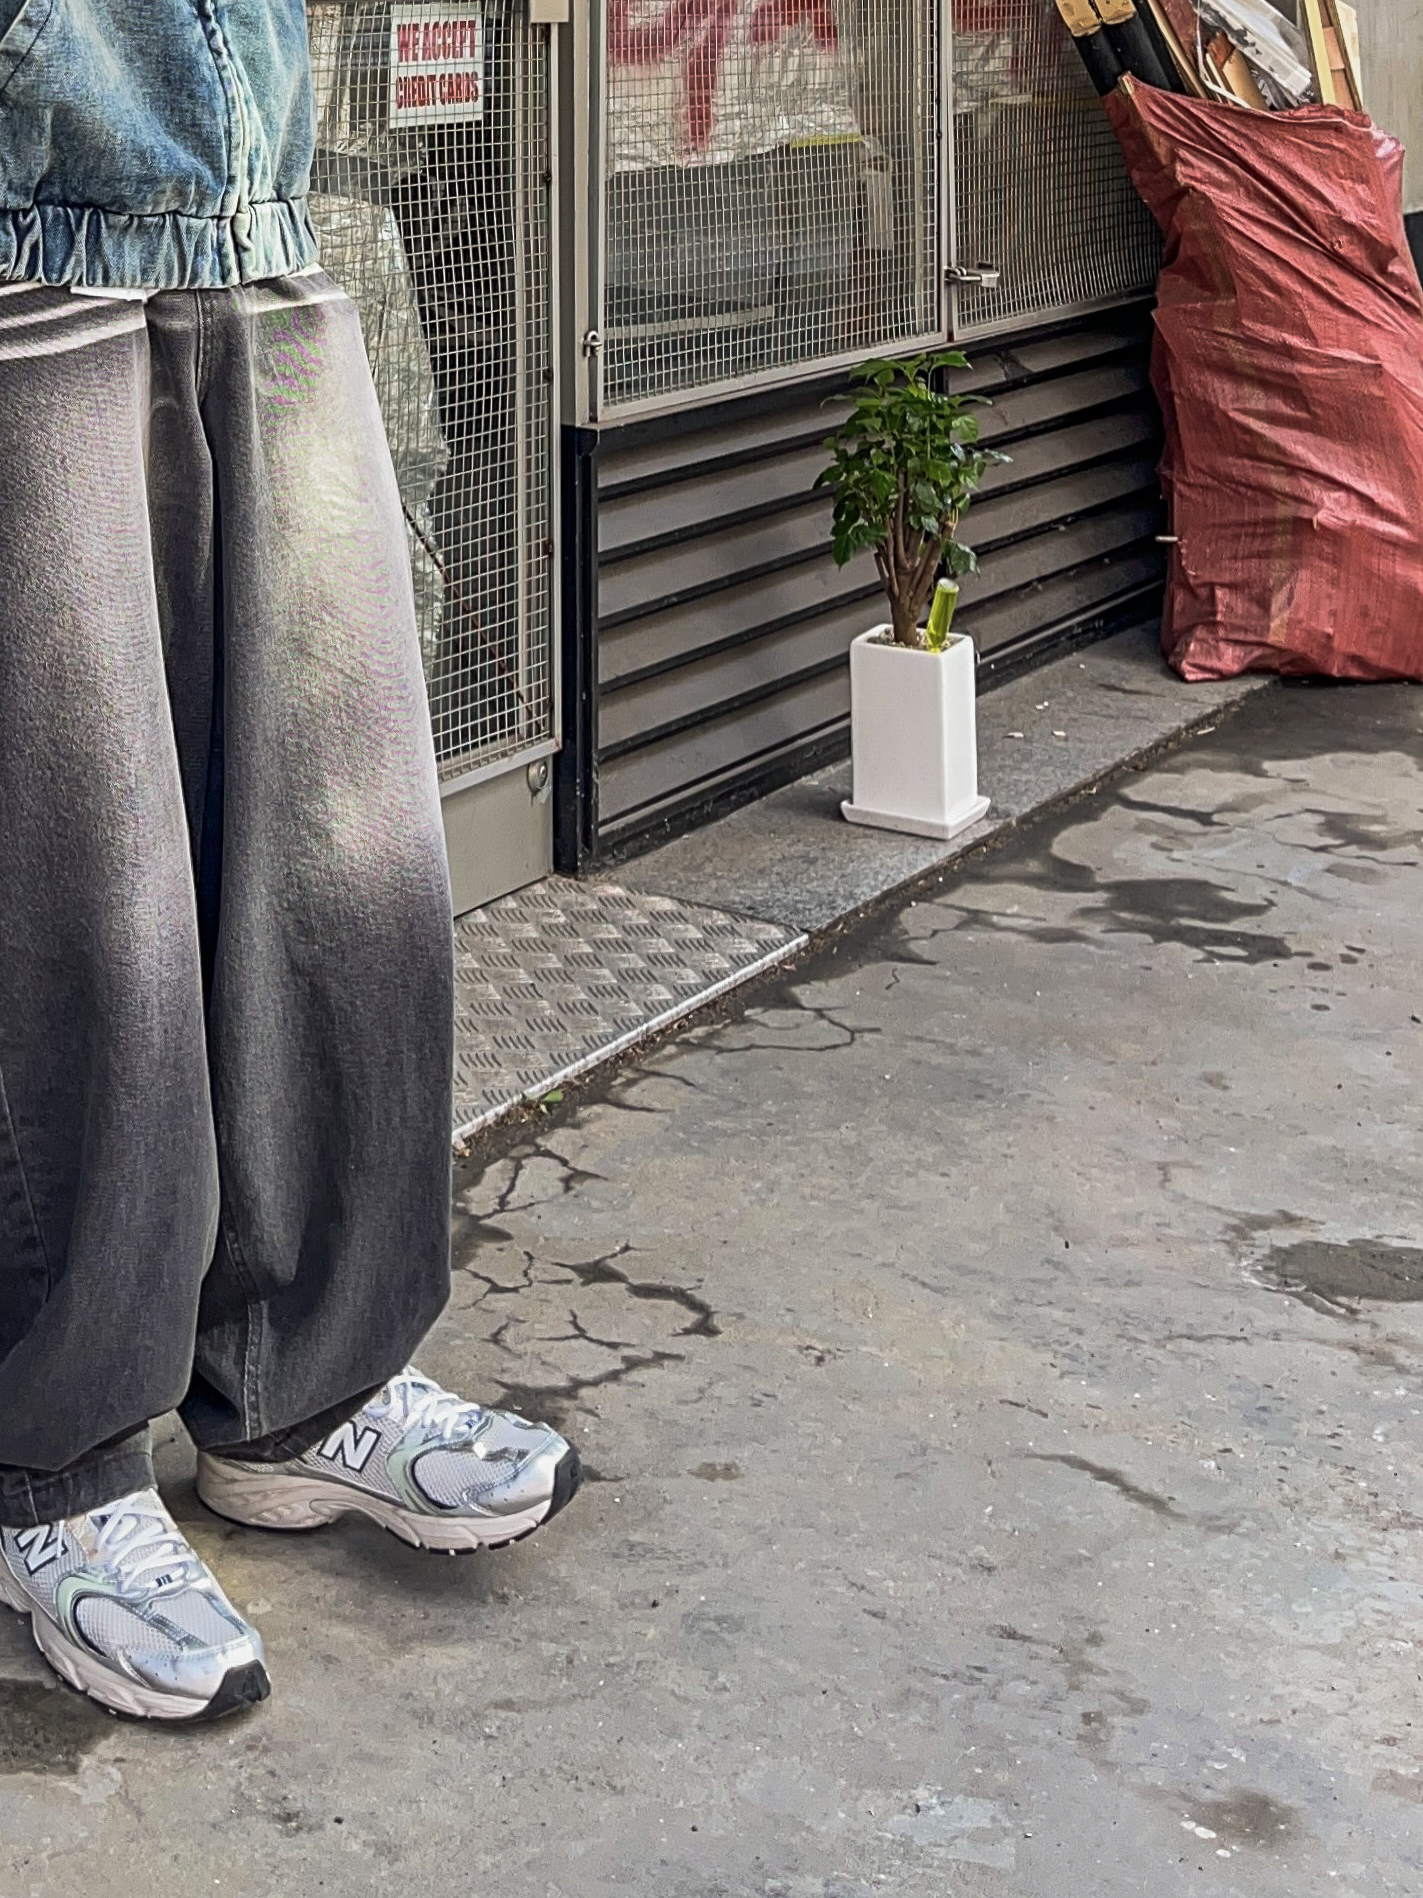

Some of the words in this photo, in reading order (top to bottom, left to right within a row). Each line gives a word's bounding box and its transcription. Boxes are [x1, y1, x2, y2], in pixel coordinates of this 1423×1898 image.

[396, 23, 420, 62] WE
[421, 20, 477, 61] ACCEPT
[395, 75, 437, 110] CREDIT
[439, 71, 479, 105] CARDS
[317, 1419, 382, 1473] N
